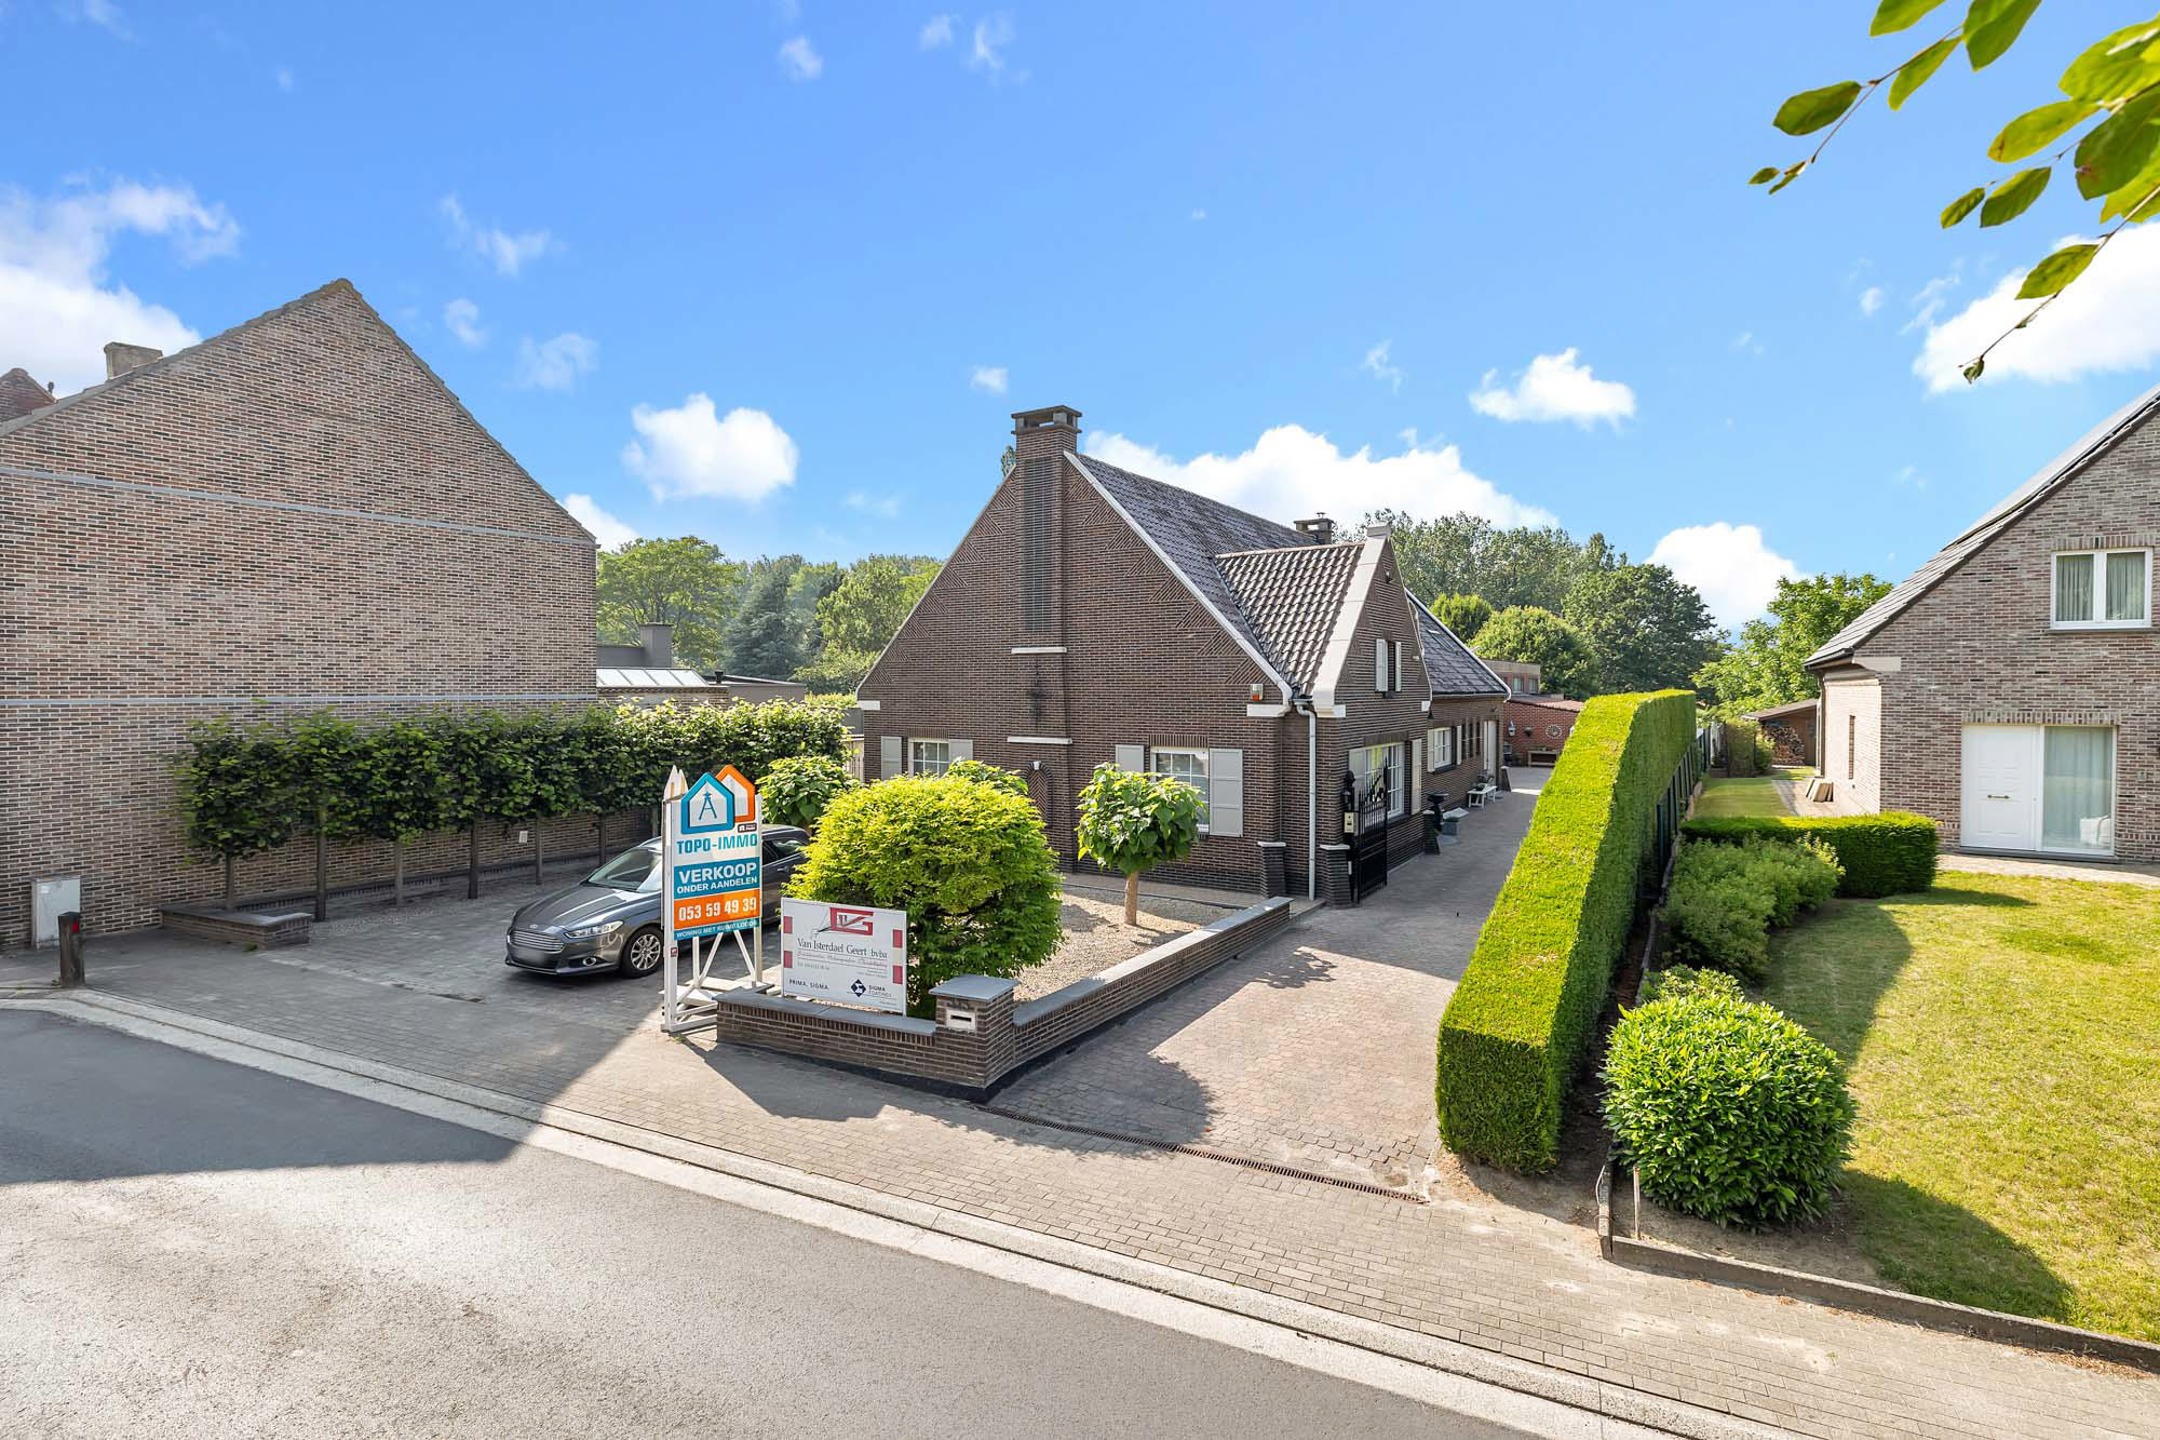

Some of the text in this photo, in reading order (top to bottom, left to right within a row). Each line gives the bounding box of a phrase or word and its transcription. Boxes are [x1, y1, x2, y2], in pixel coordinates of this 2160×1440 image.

[676, 834, 758, 854] TOPO-IMMO
[679, 862, 757, 884] VERKOOP
[676, 875, 757, 894] ONDER AANDELEN
[679, 896, 757, 921] 053 59 49 39
[703, 926, 716, 934] MET
[797, 937, 812, 949] Van
[846, 944, 868, 957] Geert
[871, 950, 888, 959] bvba
[810, 982, 829, 991] SIGMA
[868, 984, 886, 993] SIGMA
